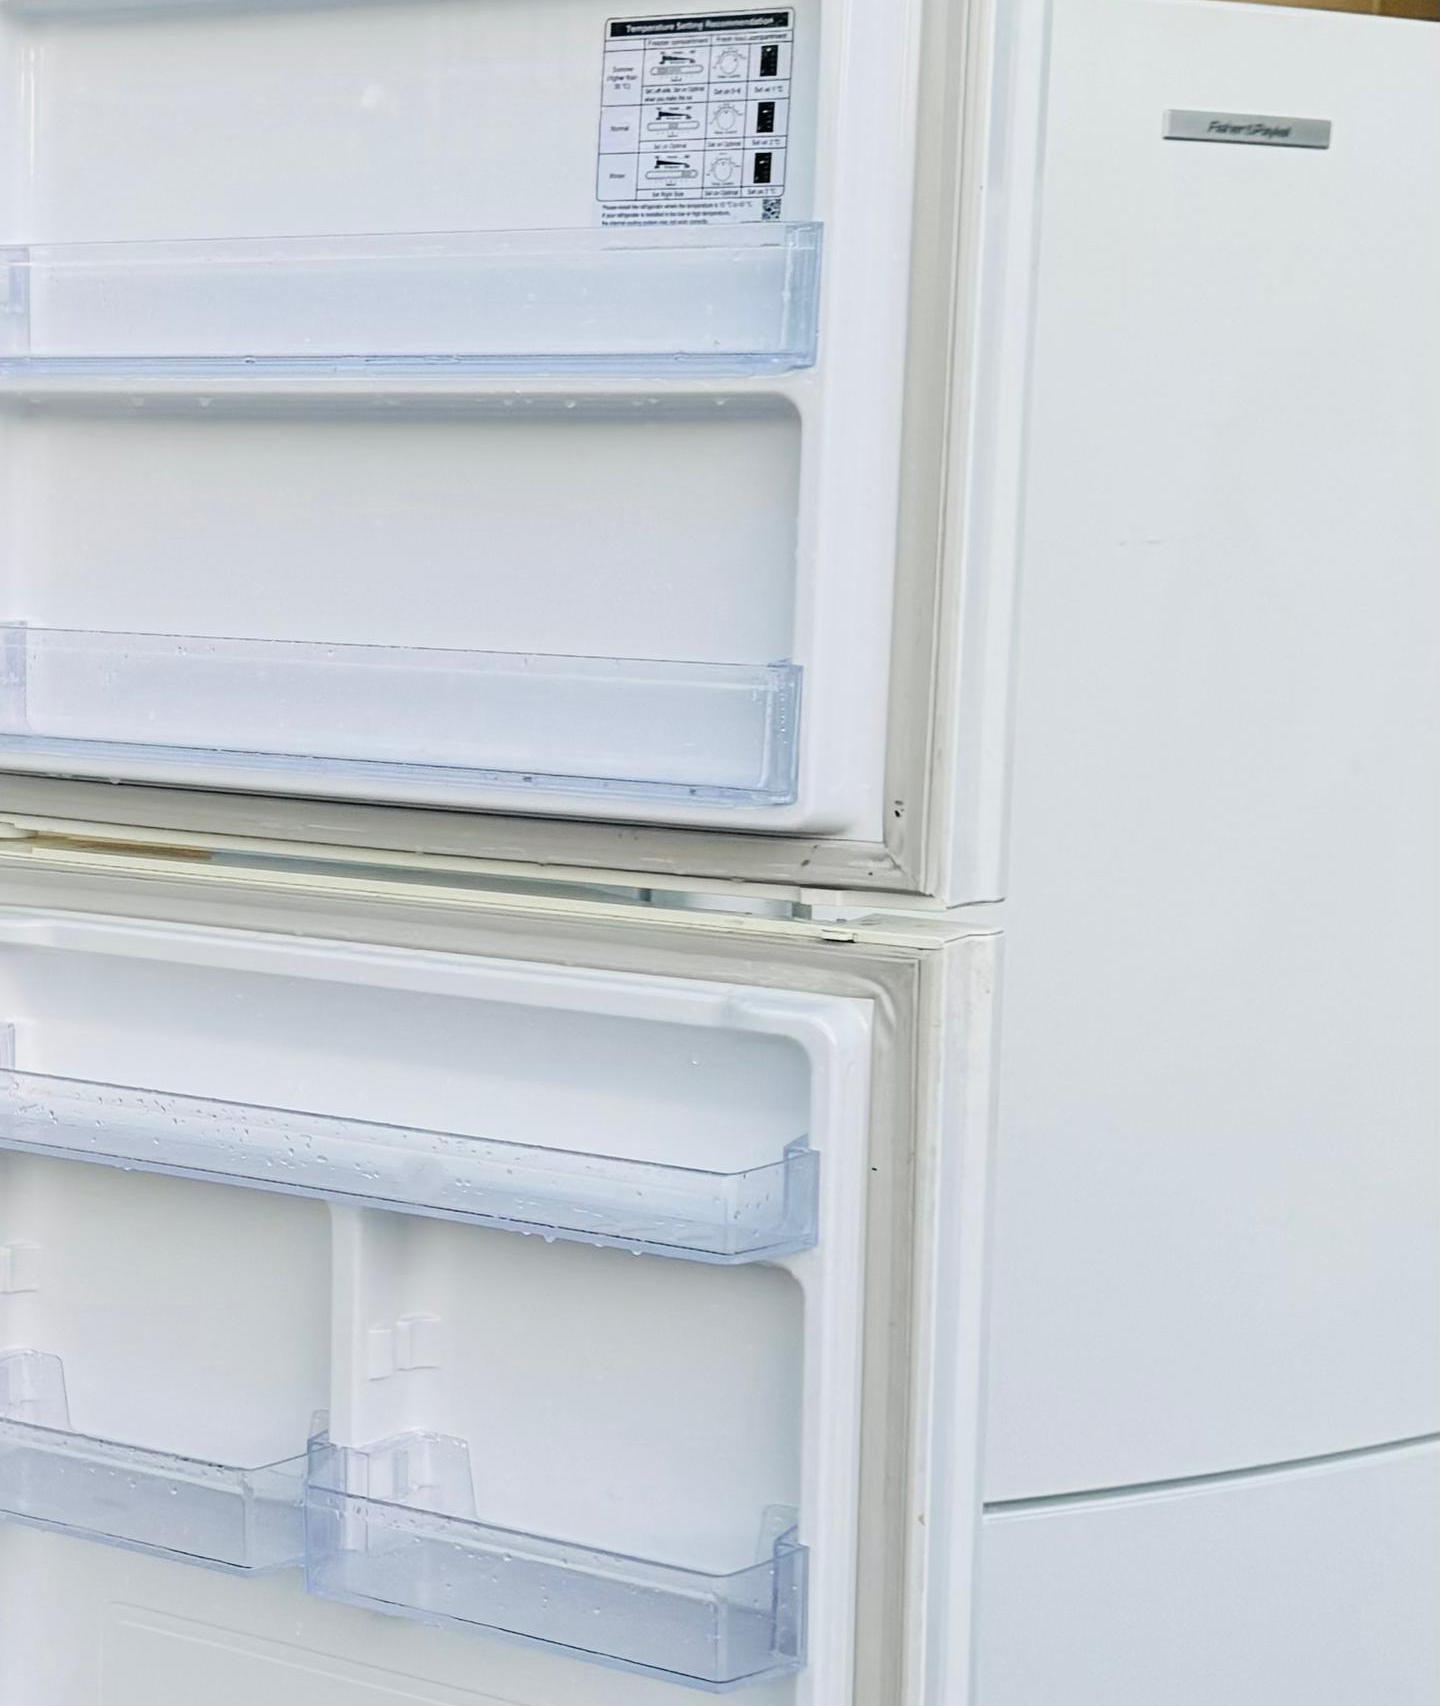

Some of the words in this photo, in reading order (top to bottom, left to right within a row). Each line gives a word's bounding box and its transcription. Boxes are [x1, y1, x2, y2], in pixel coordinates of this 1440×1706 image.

[626, 23, 675, 34] Temperature
[676, 21, 703, 31] Setting
[705, 17, 774, 28] Recommendation
